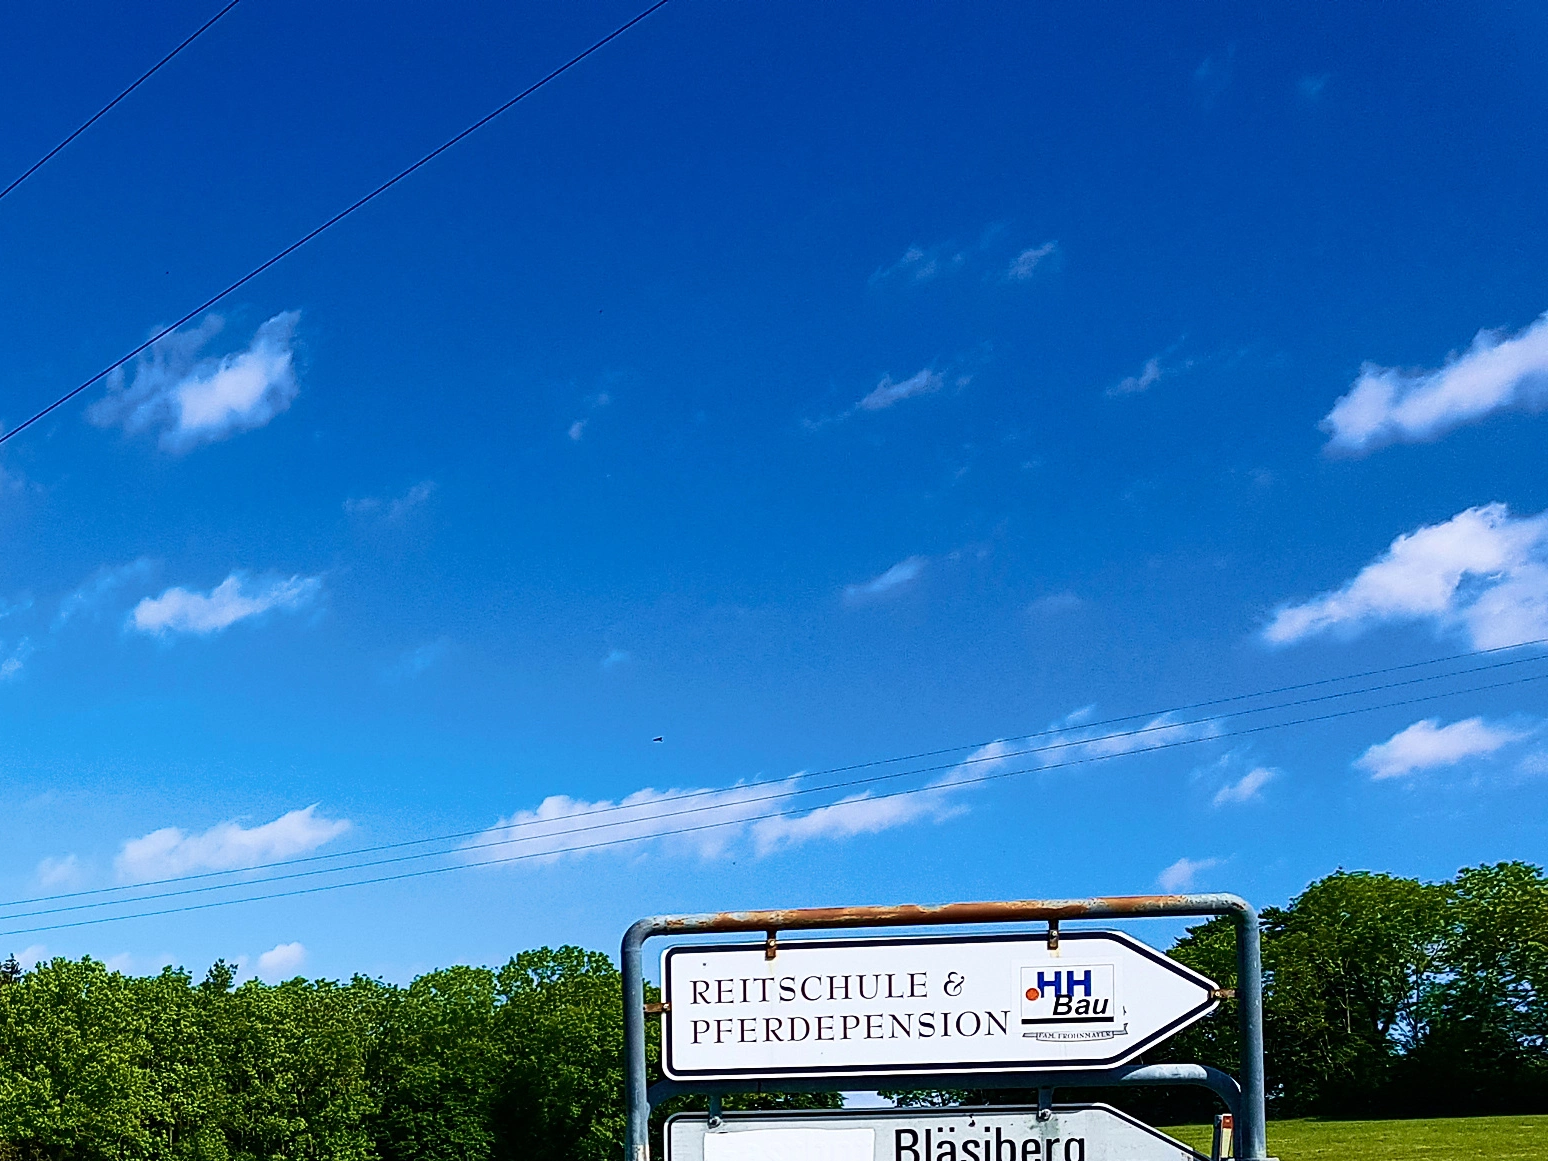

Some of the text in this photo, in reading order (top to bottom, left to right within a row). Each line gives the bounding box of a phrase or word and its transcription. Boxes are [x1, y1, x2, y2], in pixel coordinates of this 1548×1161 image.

[689, 971, 965, 1005] REITSCHULE &
[1036, 969, 1092, 999] HH
[1052, 993, 1109, 1016] Bau
[689, 1010, 1011, 1045] PFERDEPENSION
